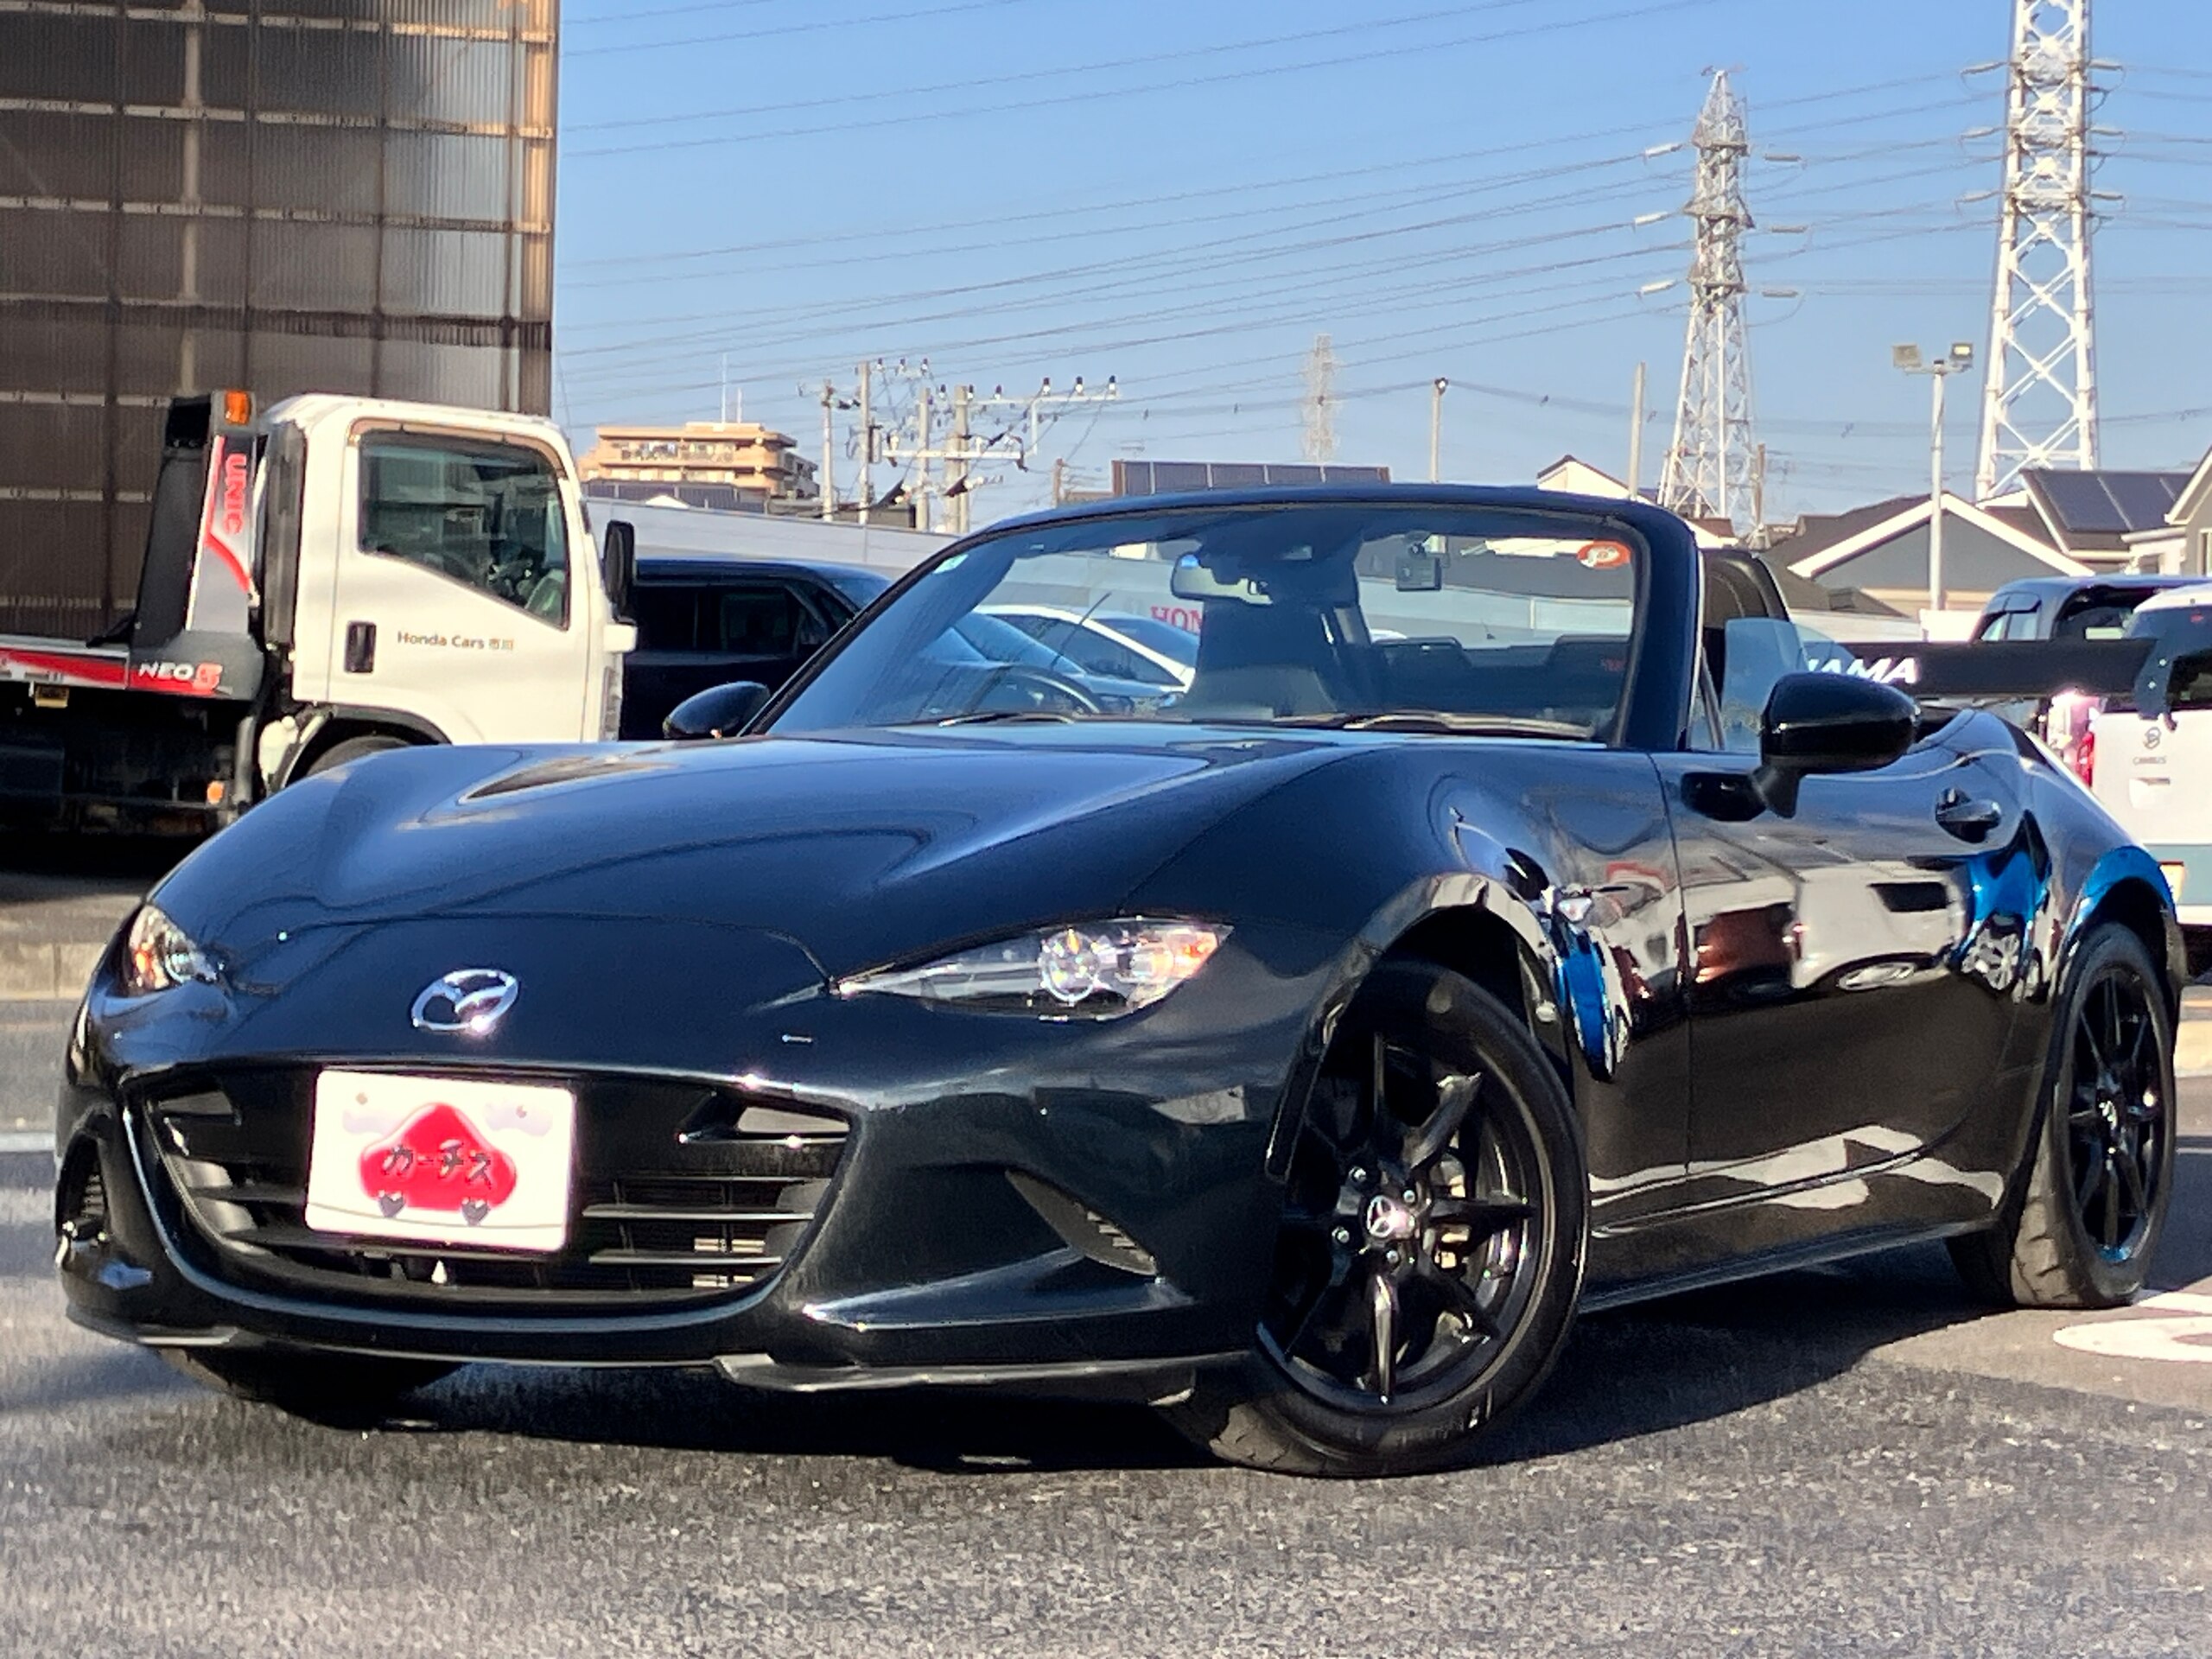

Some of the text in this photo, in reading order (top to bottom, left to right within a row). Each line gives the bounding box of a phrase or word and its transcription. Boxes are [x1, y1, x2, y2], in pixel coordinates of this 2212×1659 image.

[397, 631, 447, 646] Honda
[451, 635, 484, 649] Cars
[382, 1138, 491, 1190] カーチス
